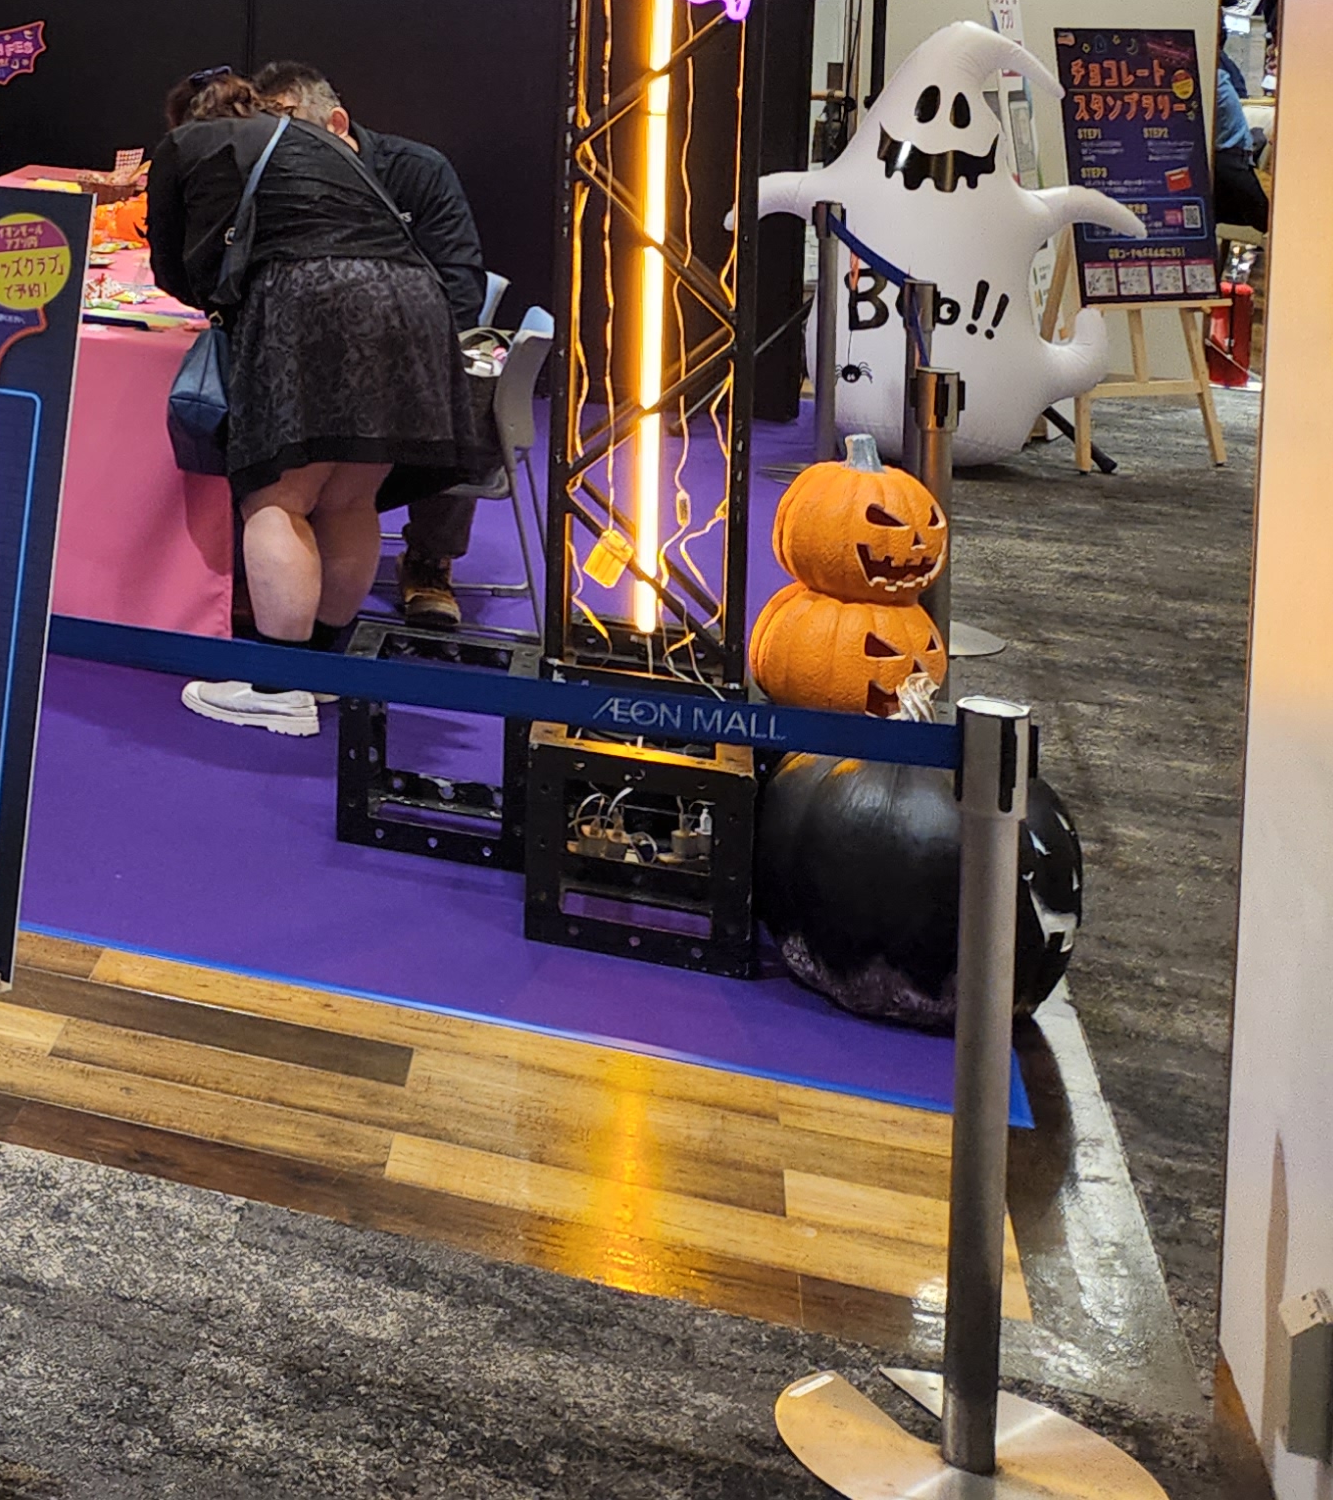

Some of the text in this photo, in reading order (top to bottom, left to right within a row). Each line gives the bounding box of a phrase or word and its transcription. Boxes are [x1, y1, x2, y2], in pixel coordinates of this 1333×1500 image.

[5, 41, 33, 56] FES
[1070, 58, 1165, 86] チョコレート
[1073, 92, 1186, 121] スタンプラリー
[844, 268, 1009, 340] Bo!!
[692, 706, 787, 740] MALL
